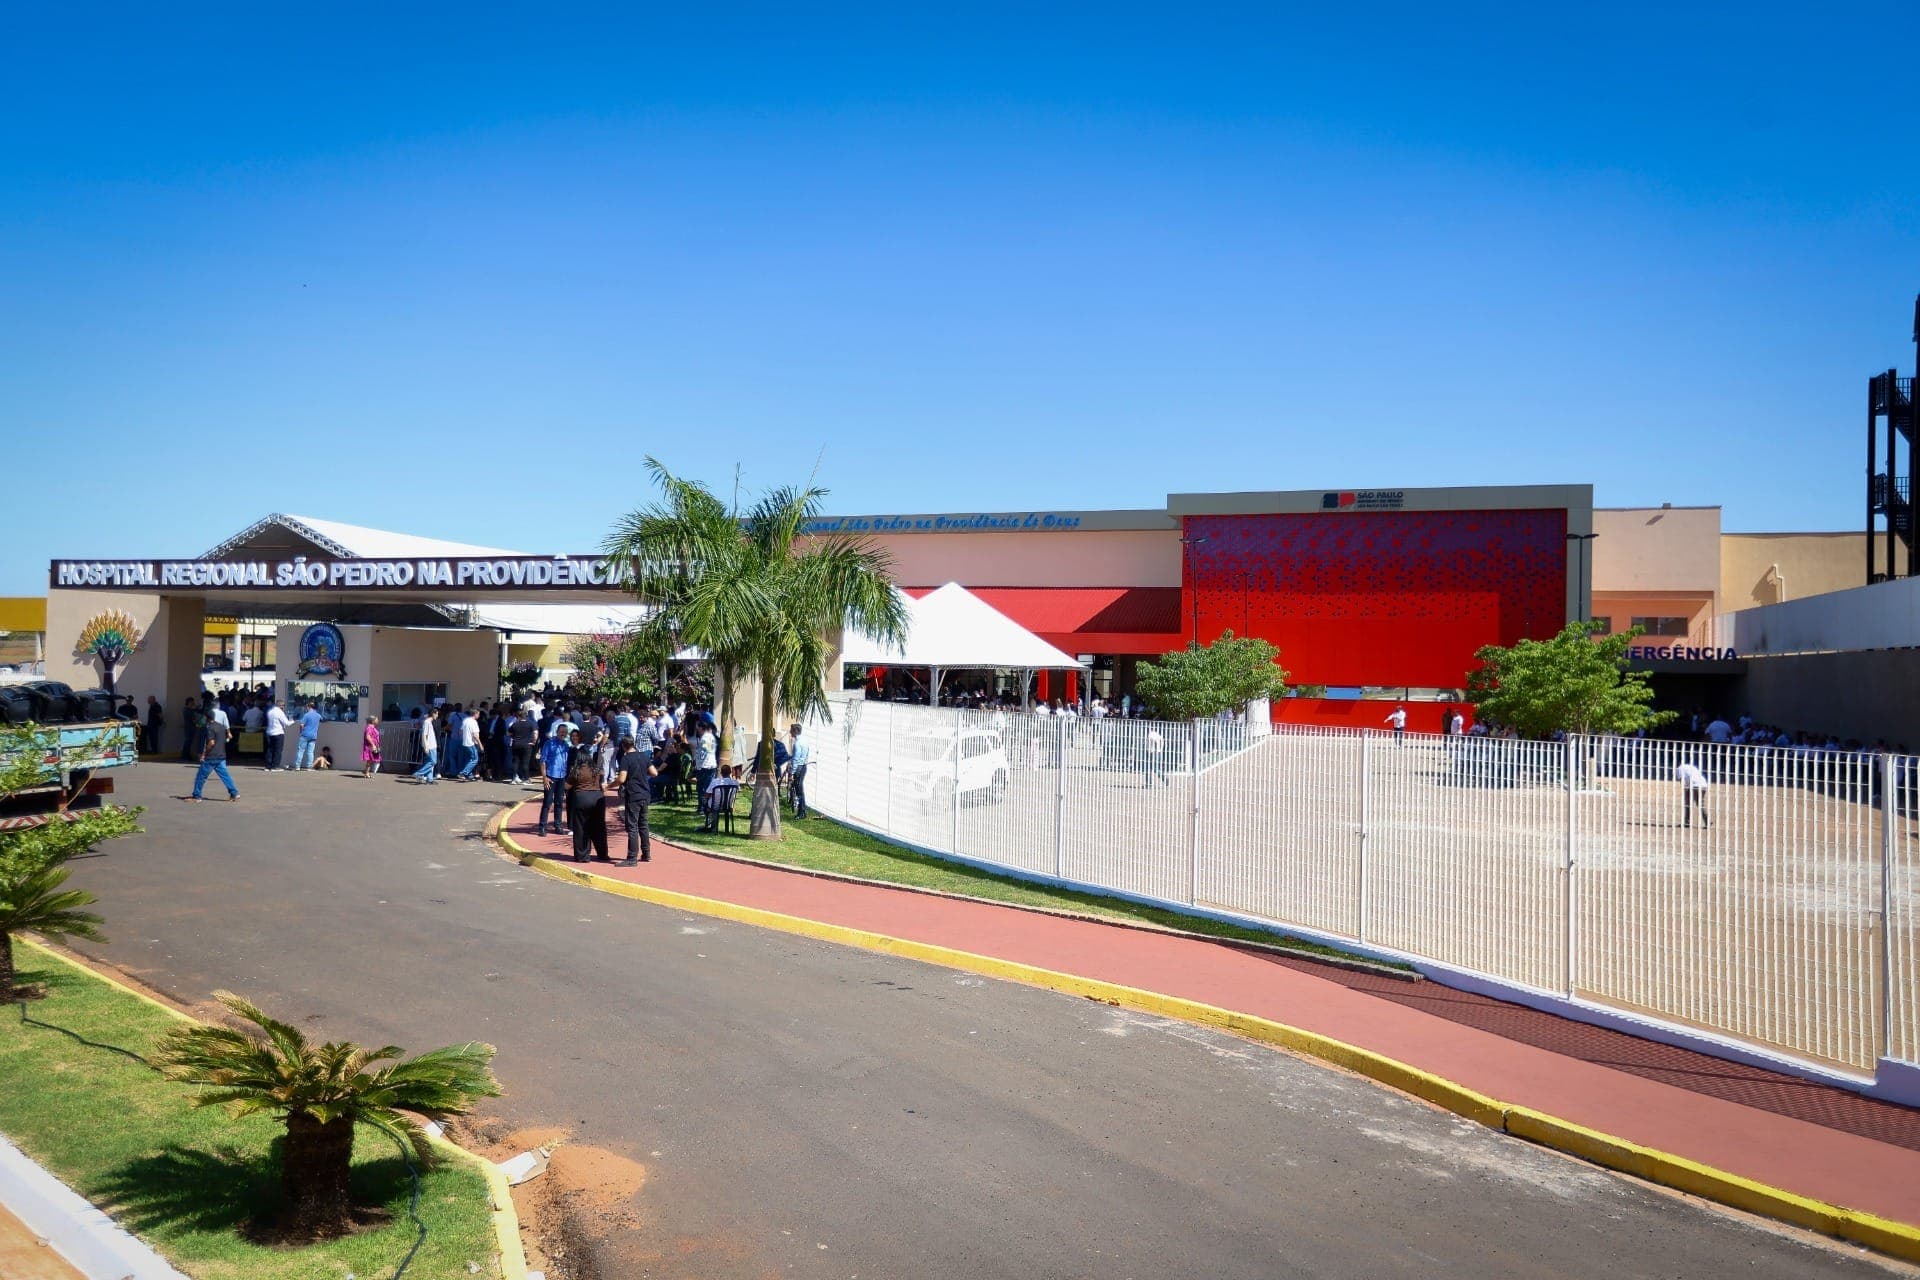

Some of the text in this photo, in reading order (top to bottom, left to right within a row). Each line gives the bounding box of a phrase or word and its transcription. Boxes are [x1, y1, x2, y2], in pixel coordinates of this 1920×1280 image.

[1376, 490, 1404, 498] PAULO
[873, 515, 912, 530] Pedro
[935, 514, 1018, 529] Providência
[1043, 514, 1081, 529] Deus
[58, 562, 158, 586] HOSPITAL
[161, 562, 274, 586] REGIONAL
[276, 556, 327, 586] SÃO
[330, 560, 414, 586] PEDRO
[418, 560, 453, 586] NA
[457, 552, 637, 585] PROVIDÊNCIA
[1616, 643, 1738, 660] ERGÊNCIA
